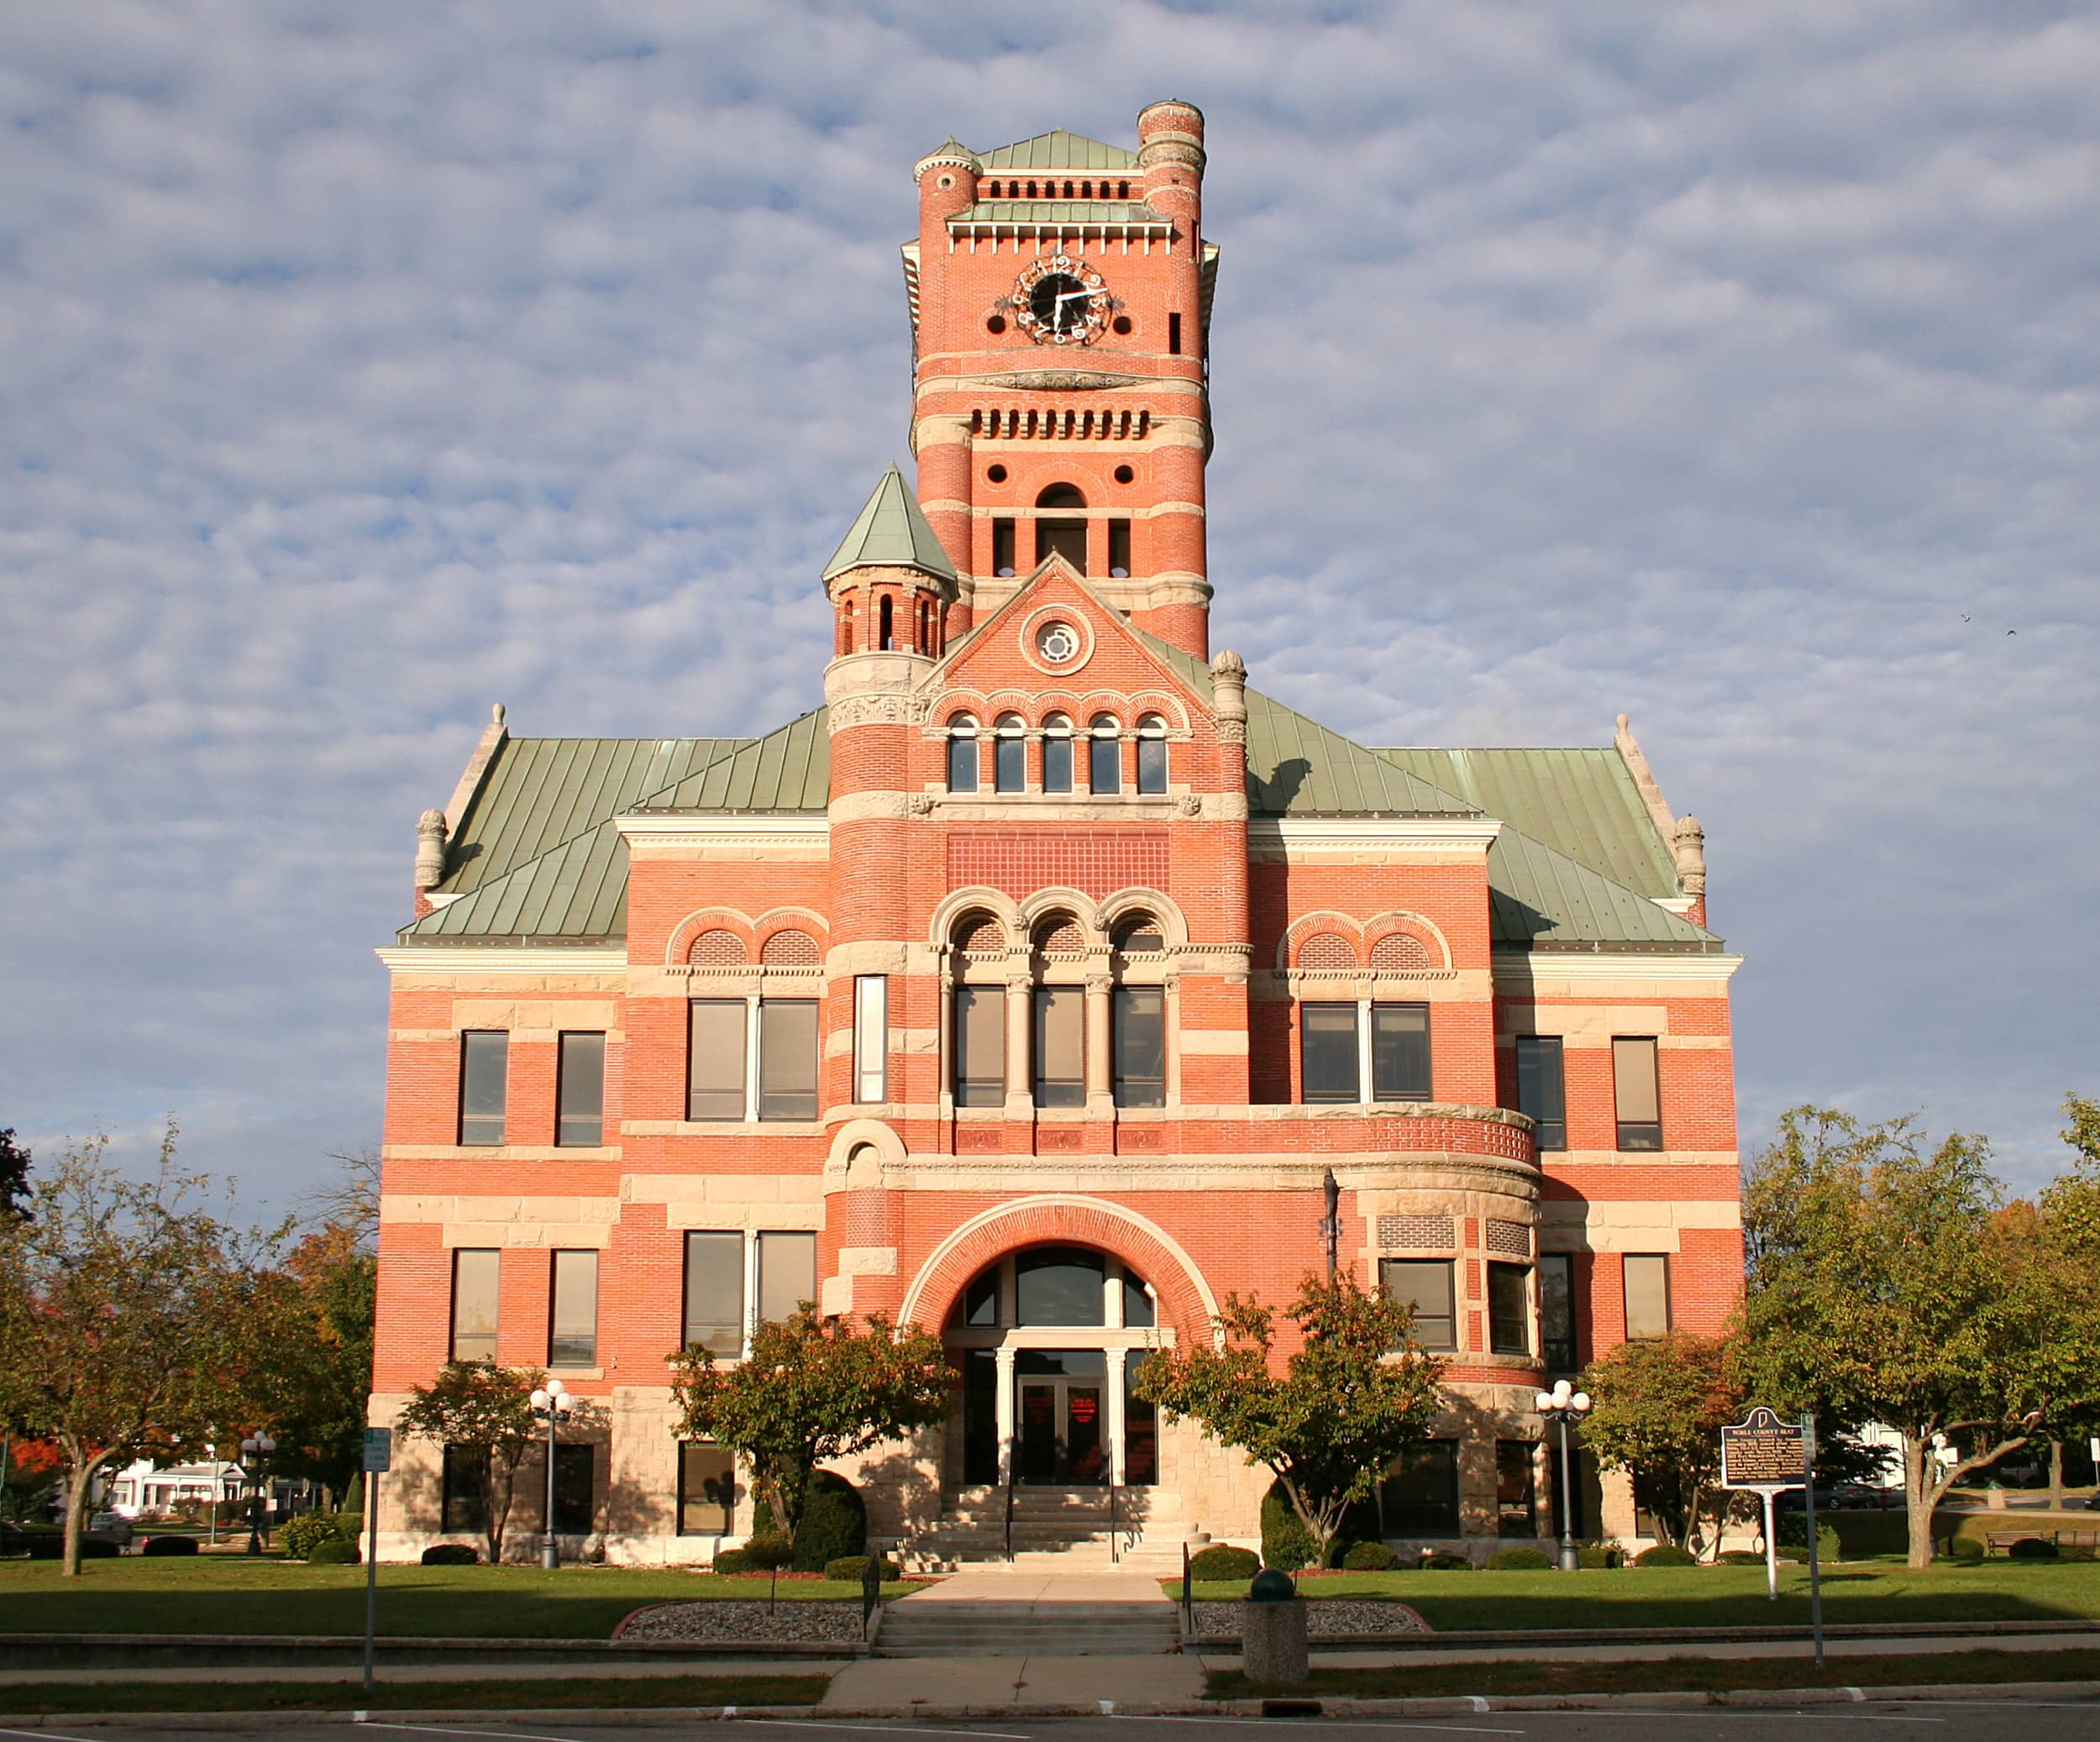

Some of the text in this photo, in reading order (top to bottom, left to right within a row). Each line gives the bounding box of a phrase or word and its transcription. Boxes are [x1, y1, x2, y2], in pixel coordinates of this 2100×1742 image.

[1050, 255, 1069, 274] 12
[1074, 261, 1084, 277] 1
[1083, 274, 1101, 291] 2
[1012, 293, 1030, 304] 9
[1018, 312, 1035, 324] 8
[1085, 314, 1100, 327] 4
[1035, 322, 1050, 338] 7
[1053, 328, 1066, 344] 6
[1071, 322, 1086, 339] 5
